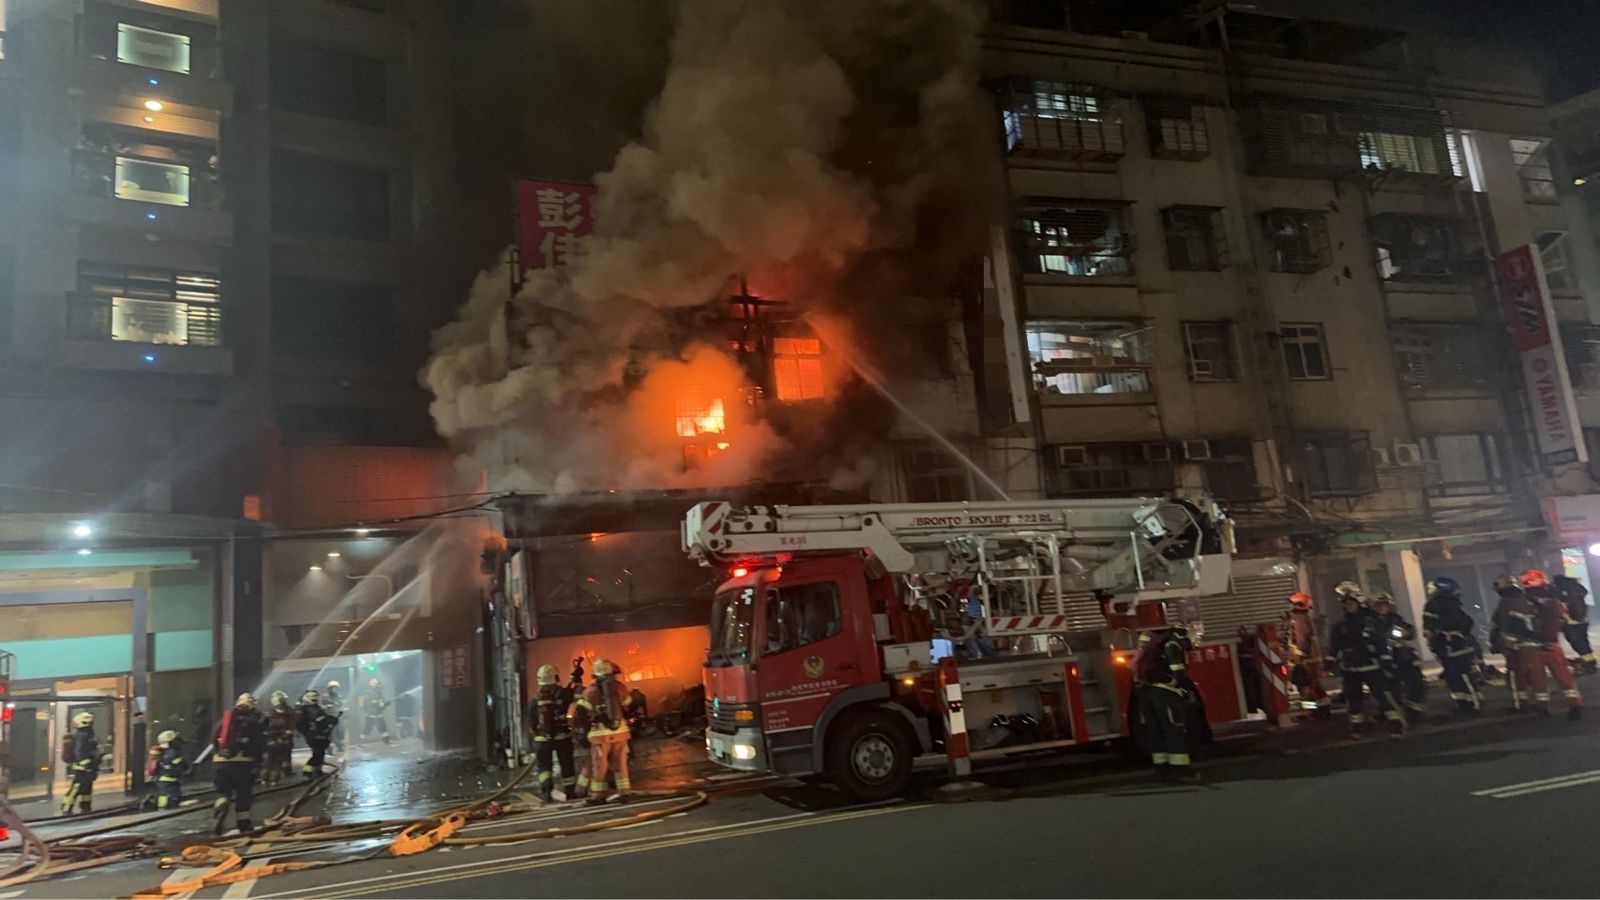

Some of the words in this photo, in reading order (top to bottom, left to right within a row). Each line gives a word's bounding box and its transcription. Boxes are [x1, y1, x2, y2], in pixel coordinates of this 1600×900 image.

[1536, 375, 1566, 442] YAMAHA
[916, 516, 961, 526] BRONTO
[968, 515, 1011, 525] SKYLIFT
